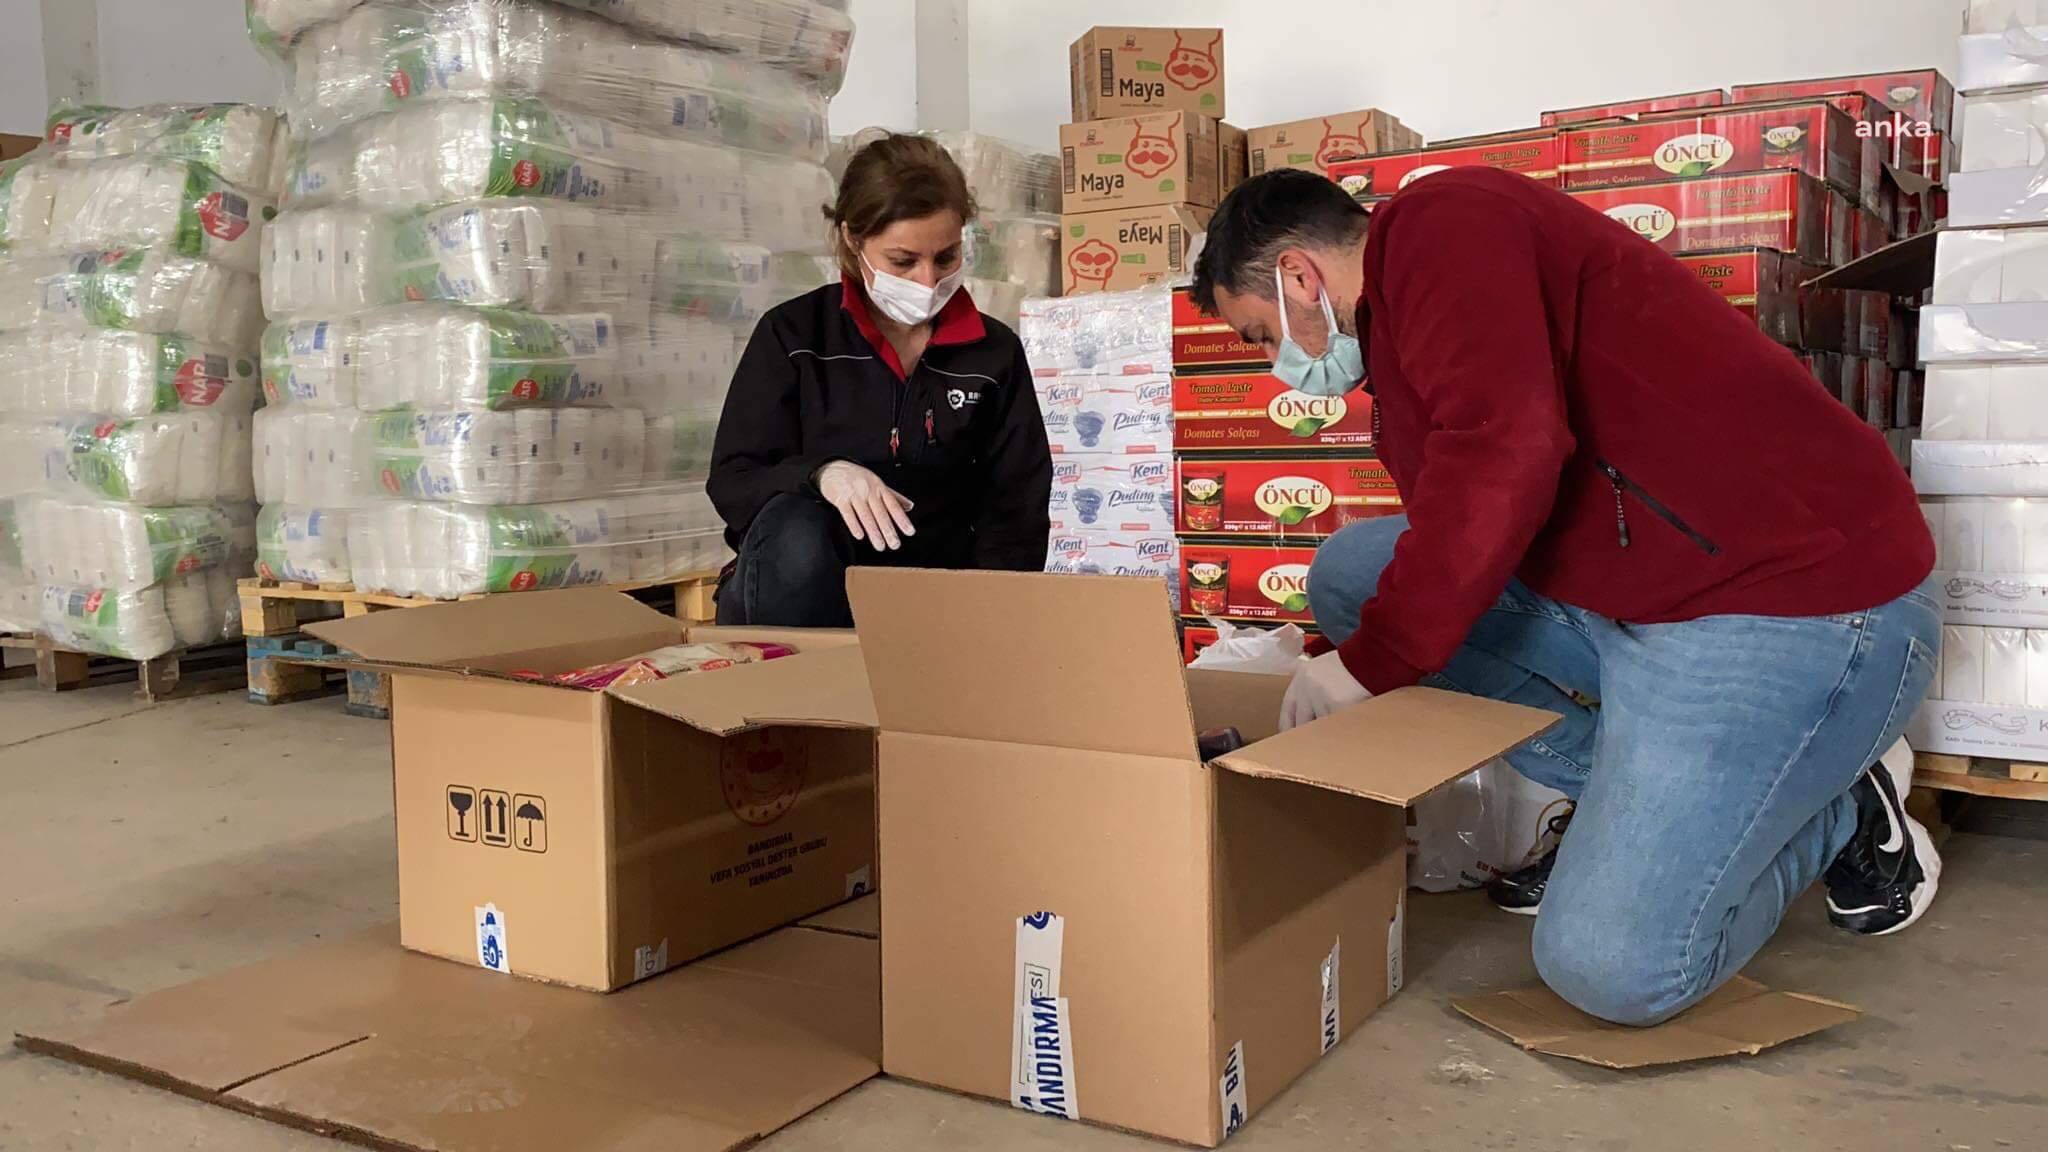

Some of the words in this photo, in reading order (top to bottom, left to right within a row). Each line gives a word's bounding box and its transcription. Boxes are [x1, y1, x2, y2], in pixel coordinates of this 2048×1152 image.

[1119, 78, 1165, 102] Maya
[1662, 139, 1725, 164] ÖNCÜ
[1081, 172, 1125, 195] Maya
[1616, 210, 1666, 231] NCÜ
[1119, 223, 1163, 245] Maya
[1699, 264, 1734, 277] Paste
[1183, 343, 1225, 354] Domates
[191, 362, 209, 403] NAR
[1139, 383, 1170, 399] Kent
[1190, 383, 1226, 394] Tomato
[1226, 381, 1253, 393] Paste
[1049, 387, 1080, 400] Kent
[1276, 395, 1338, 418] ÖNCÜ
[1112, 409, 1161, 431] Puding
[1184, 428, 1225, 439] Domates
[1227, 426, 1260, 440] Salçası
[1133, 463, 1164, 479] Kent
[1349, 467, 1389, 479] Tomato
[1107, 489, 1155, 508] Puding
[1262, 484, 1325, 506] ÖNCÜ
[1055, 536, 1083, 551] Kent
[1138, 541, 1170, 556] Kent
[1266, 571, 1308, 592] ÖNC
[710, 868, 734, 885] VEFA
